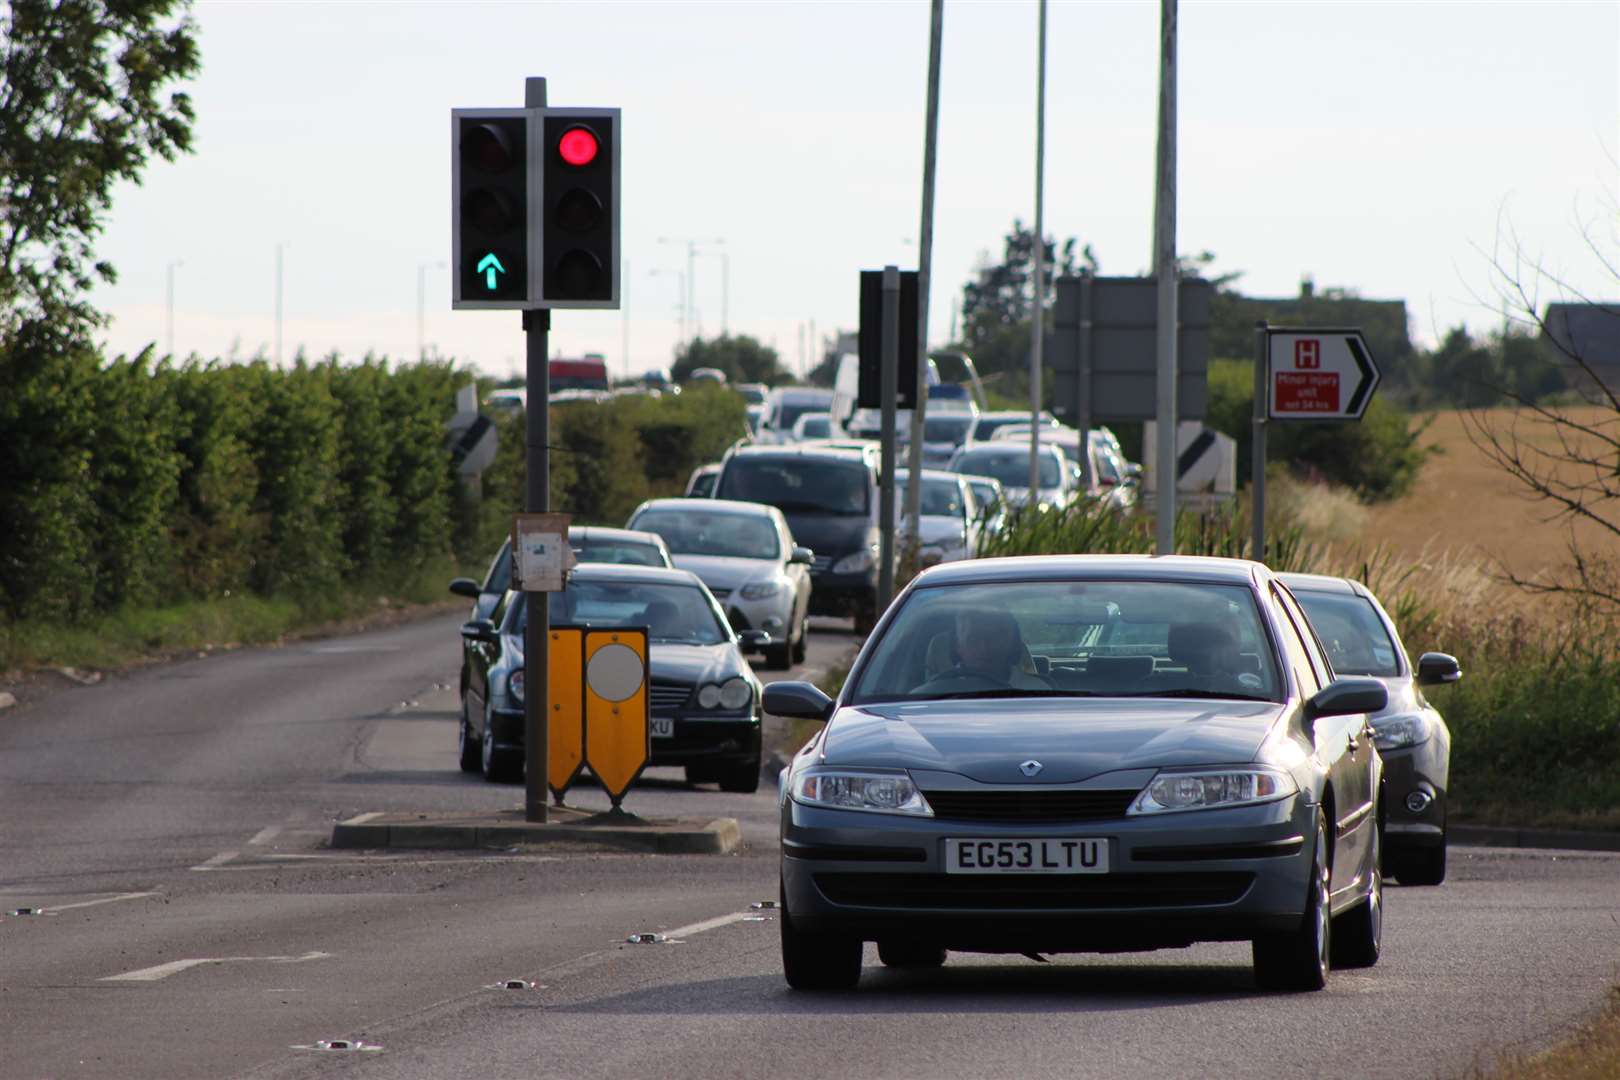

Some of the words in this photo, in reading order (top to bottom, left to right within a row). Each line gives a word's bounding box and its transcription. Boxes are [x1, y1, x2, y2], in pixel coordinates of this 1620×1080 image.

[1299, 342, 1316, 367] H
[651, 720, 670, 735] KU
[958, 842, 1034, 868] EG53
[1042, 842, 1098, 868] LTU
